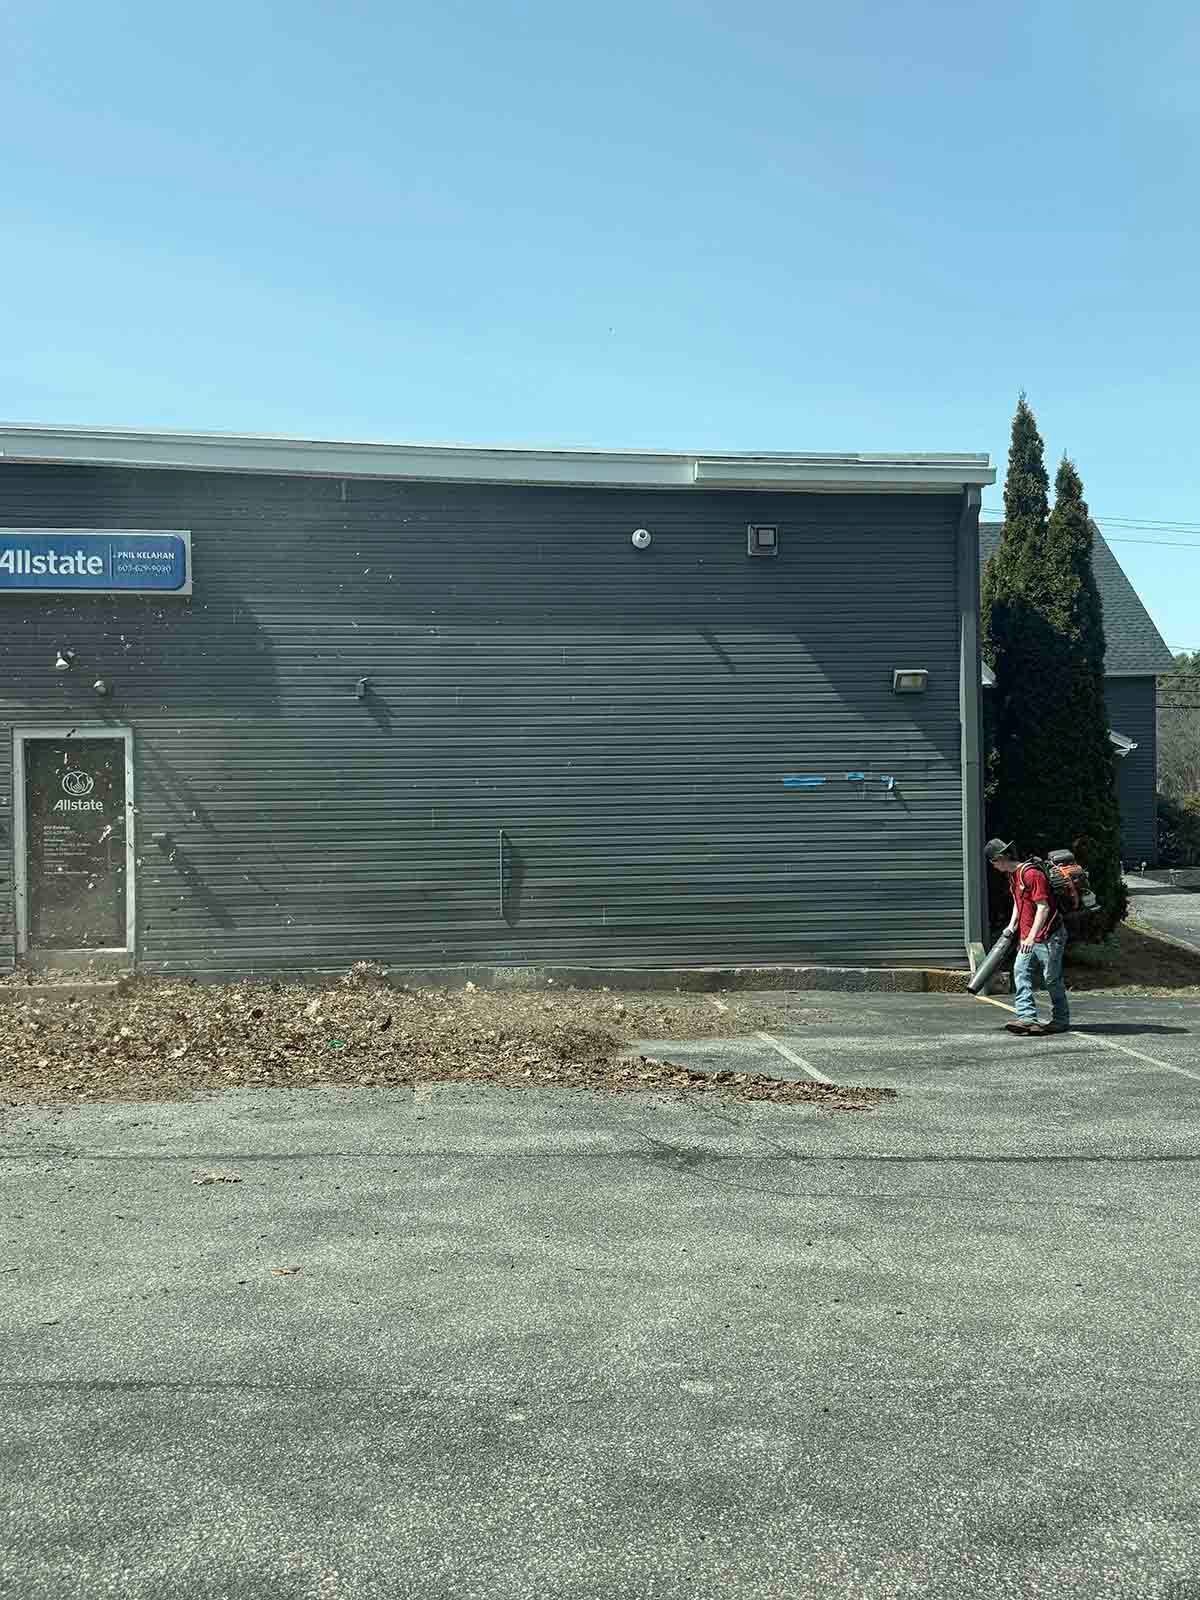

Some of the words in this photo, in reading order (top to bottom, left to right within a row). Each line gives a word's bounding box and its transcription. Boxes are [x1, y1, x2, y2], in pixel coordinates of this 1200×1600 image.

[117, 551, 135, 559] PHIL
[0, 549, 103, 575] Allstate
[53, 799, 103, 811] Allstate
